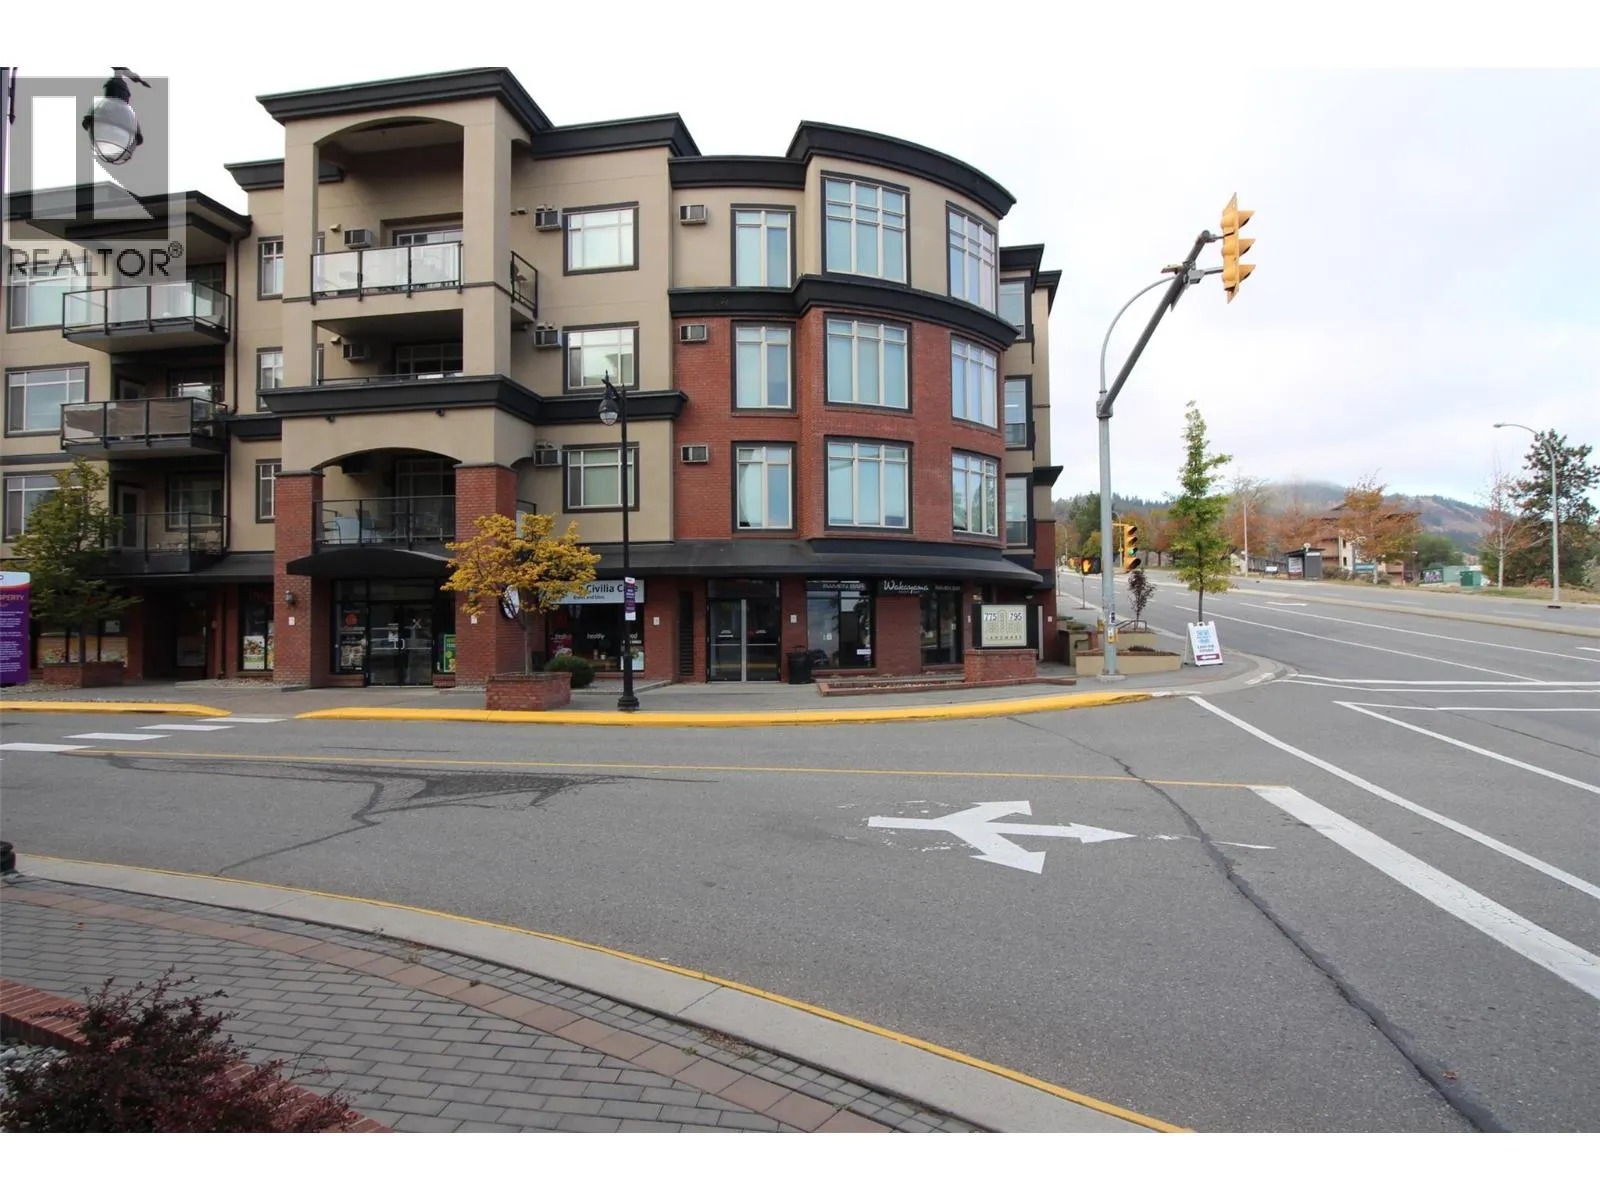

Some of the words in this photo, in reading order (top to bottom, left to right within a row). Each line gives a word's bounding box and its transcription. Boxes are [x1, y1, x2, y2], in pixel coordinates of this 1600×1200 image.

[586, 584, 615, 592] Civilia
[617, 584, 638, 592] Ce
[883, 580, 929, 594] Wakayama
[984, 612, 997, 621] 775
